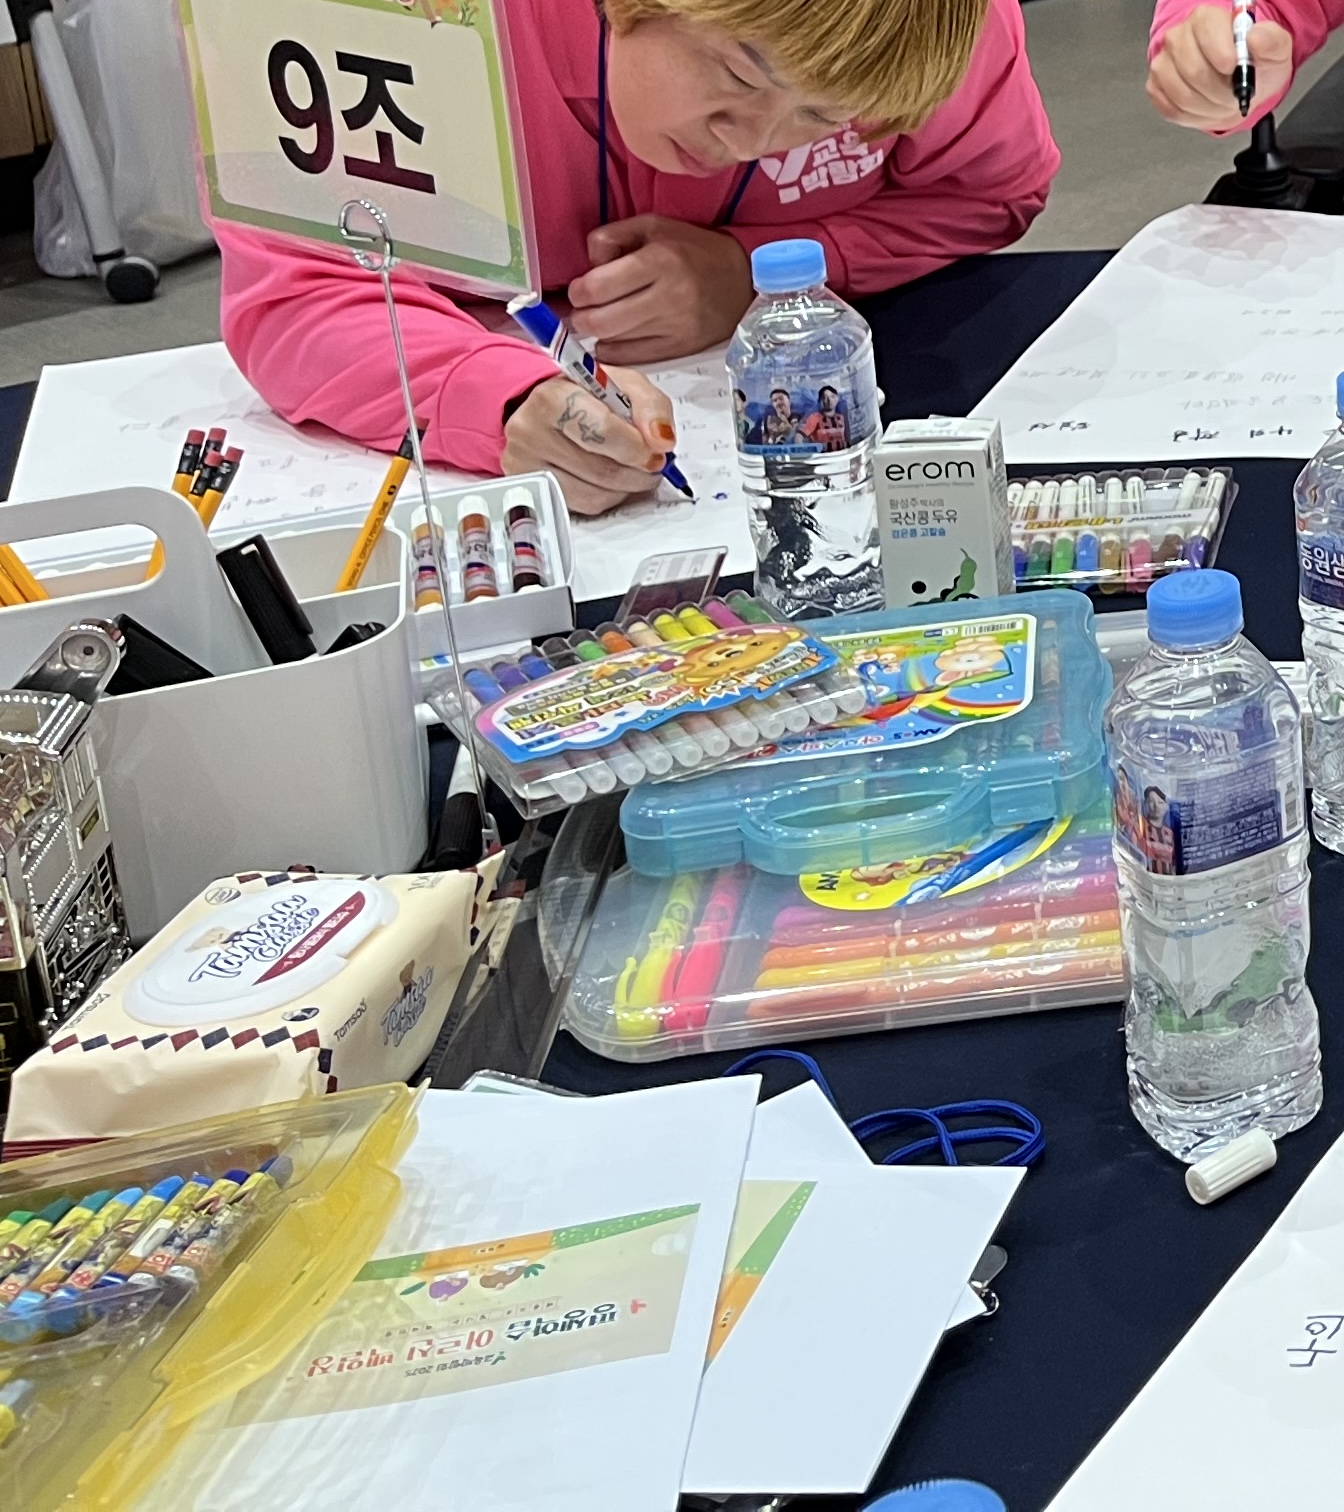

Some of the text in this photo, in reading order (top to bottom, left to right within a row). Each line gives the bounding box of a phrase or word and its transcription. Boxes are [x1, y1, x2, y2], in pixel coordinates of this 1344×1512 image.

[267, 39, 437, 195] 9조
[812, 131, 868, 168] 교육
[885, 461, 975, 481] erom
[932, 509, 957, 524] 두유
[501, 1301, 617, 1340] 평생학습
[302, 1344, 392, 1376] 백일장
[402, 1326, 494, 1360] 어르신
